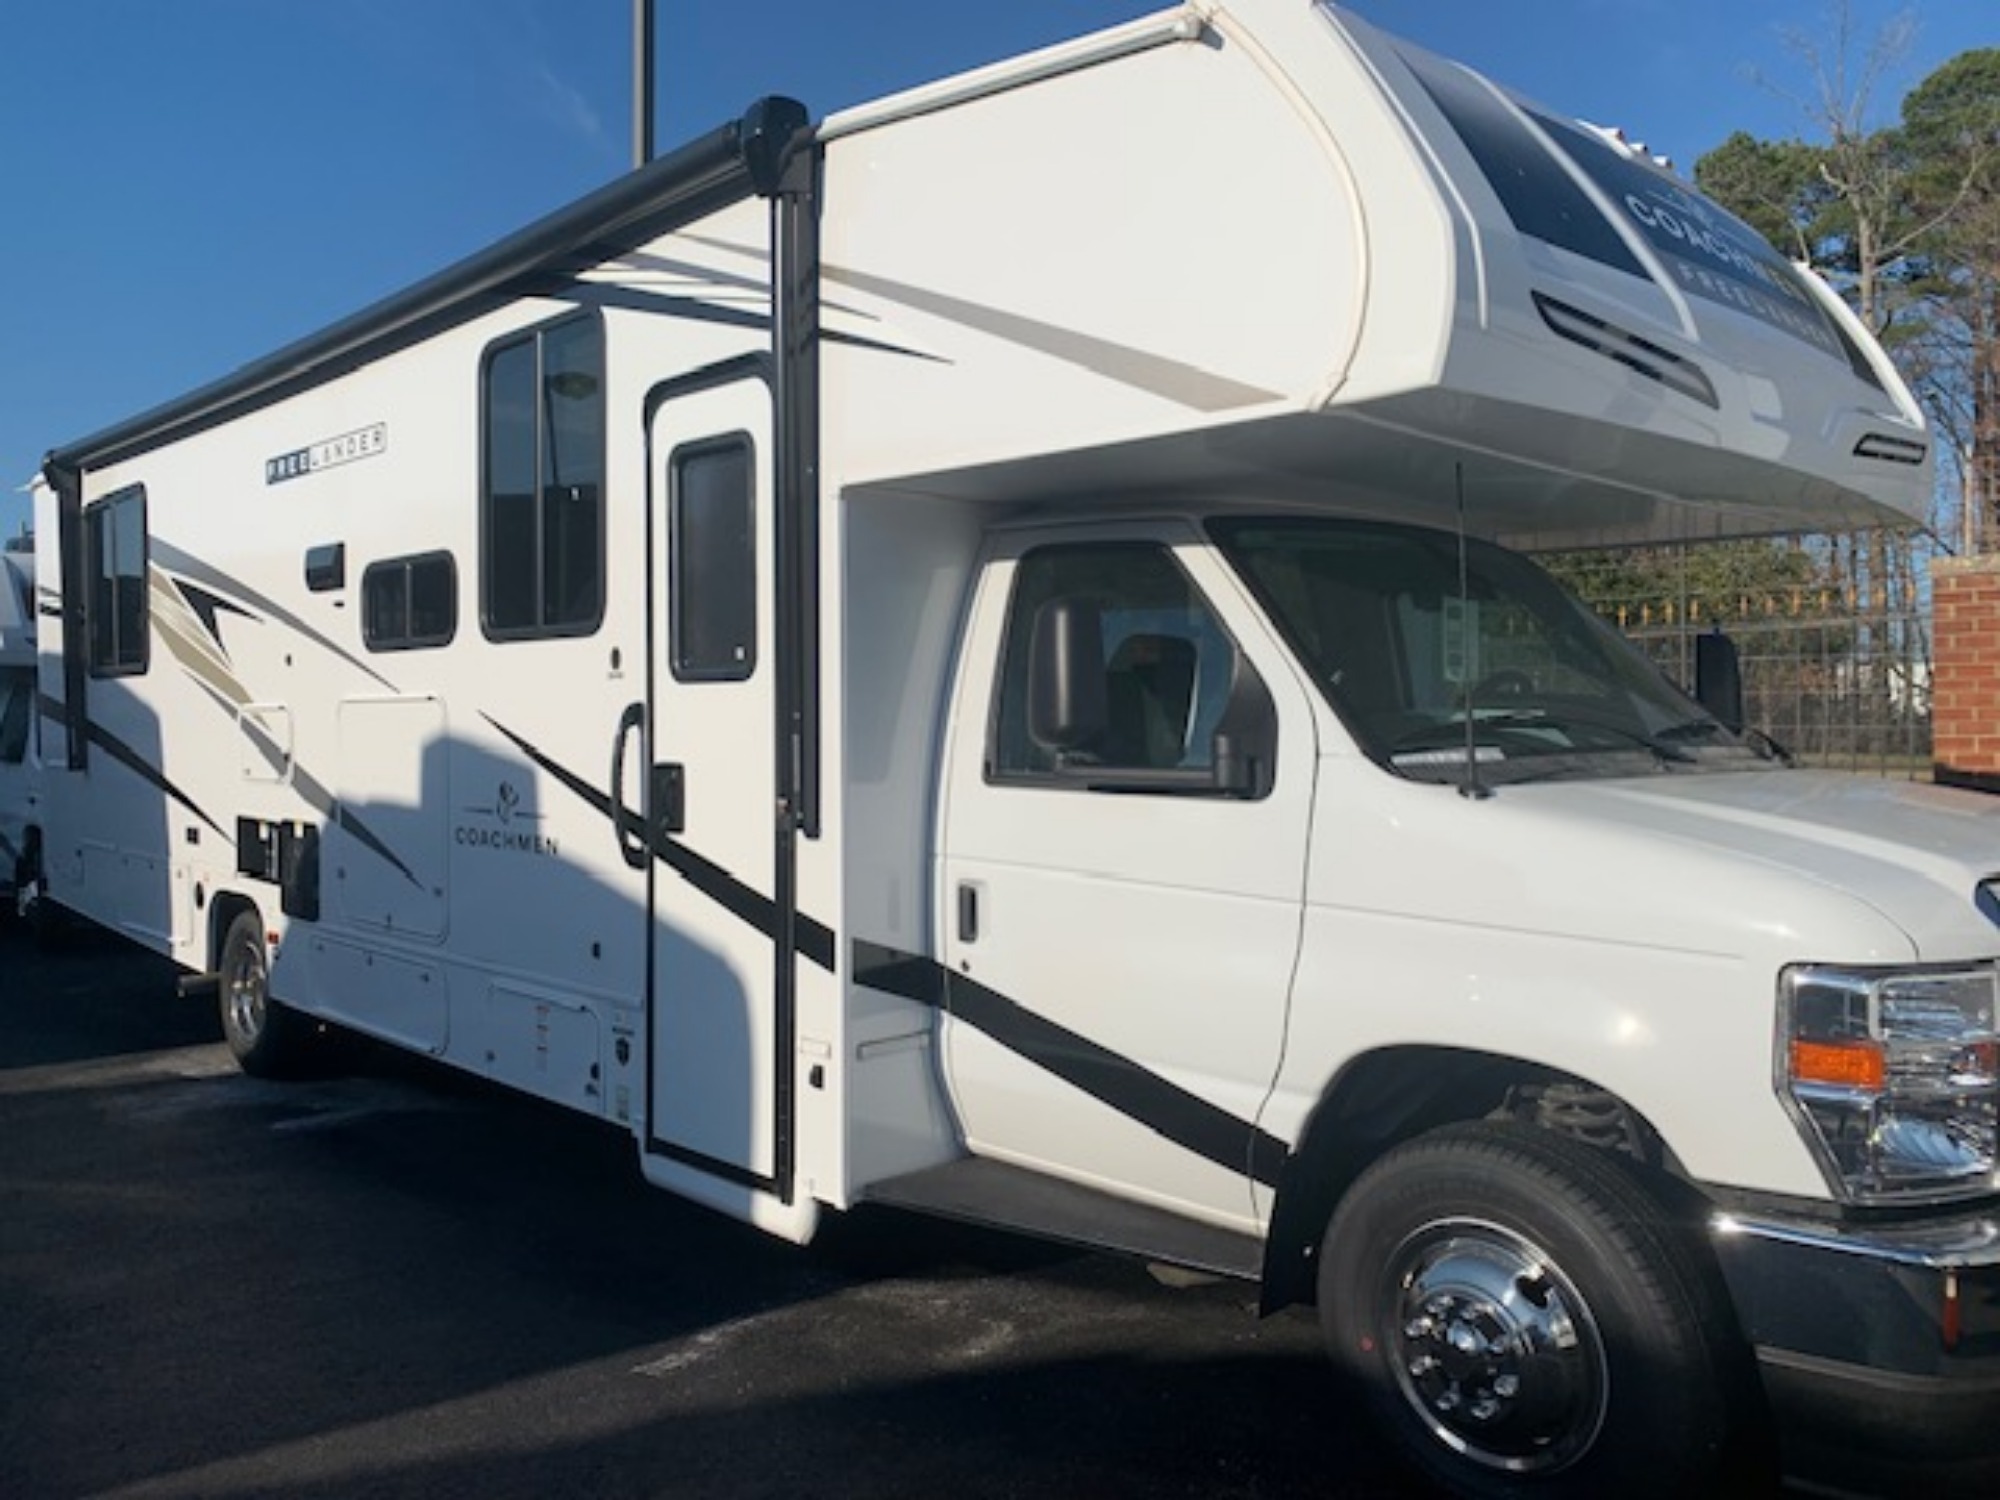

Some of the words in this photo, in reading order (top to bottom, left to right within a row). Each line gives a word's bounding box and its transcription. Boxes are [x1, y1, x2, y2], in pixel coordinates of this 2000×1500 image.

[1626, 195, 1810, 306] COACH
[1677, 262, 1836, 344] FREEL
[455, 827, 559, 856] COACHMEN
